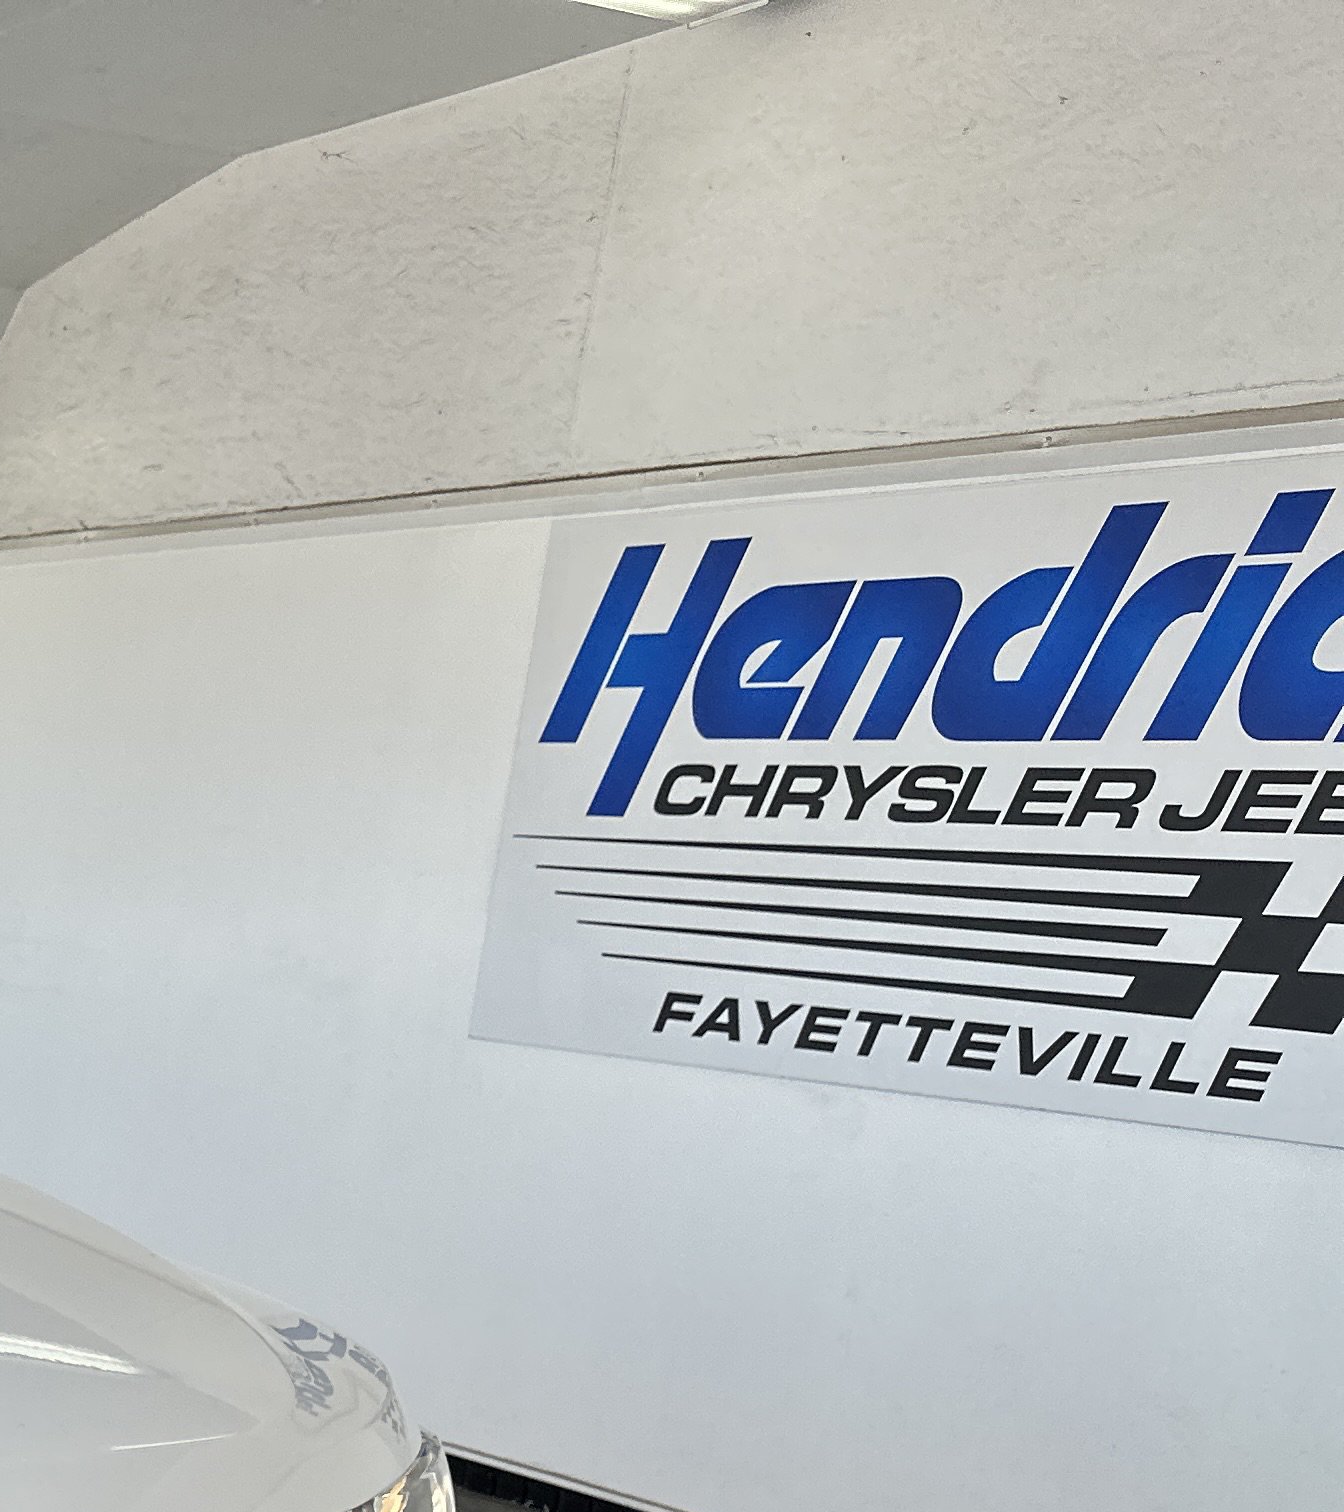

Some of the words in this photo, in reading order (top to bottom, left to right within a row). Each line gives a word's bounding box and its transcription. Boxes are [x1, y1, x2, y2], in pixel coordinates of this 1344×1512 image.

[538, 488, 1344, 818] Hendric
[653, 763, 1157, 828] CHRYSLER
[651, 991, 1284, 1102] FAYETTEVILLE
